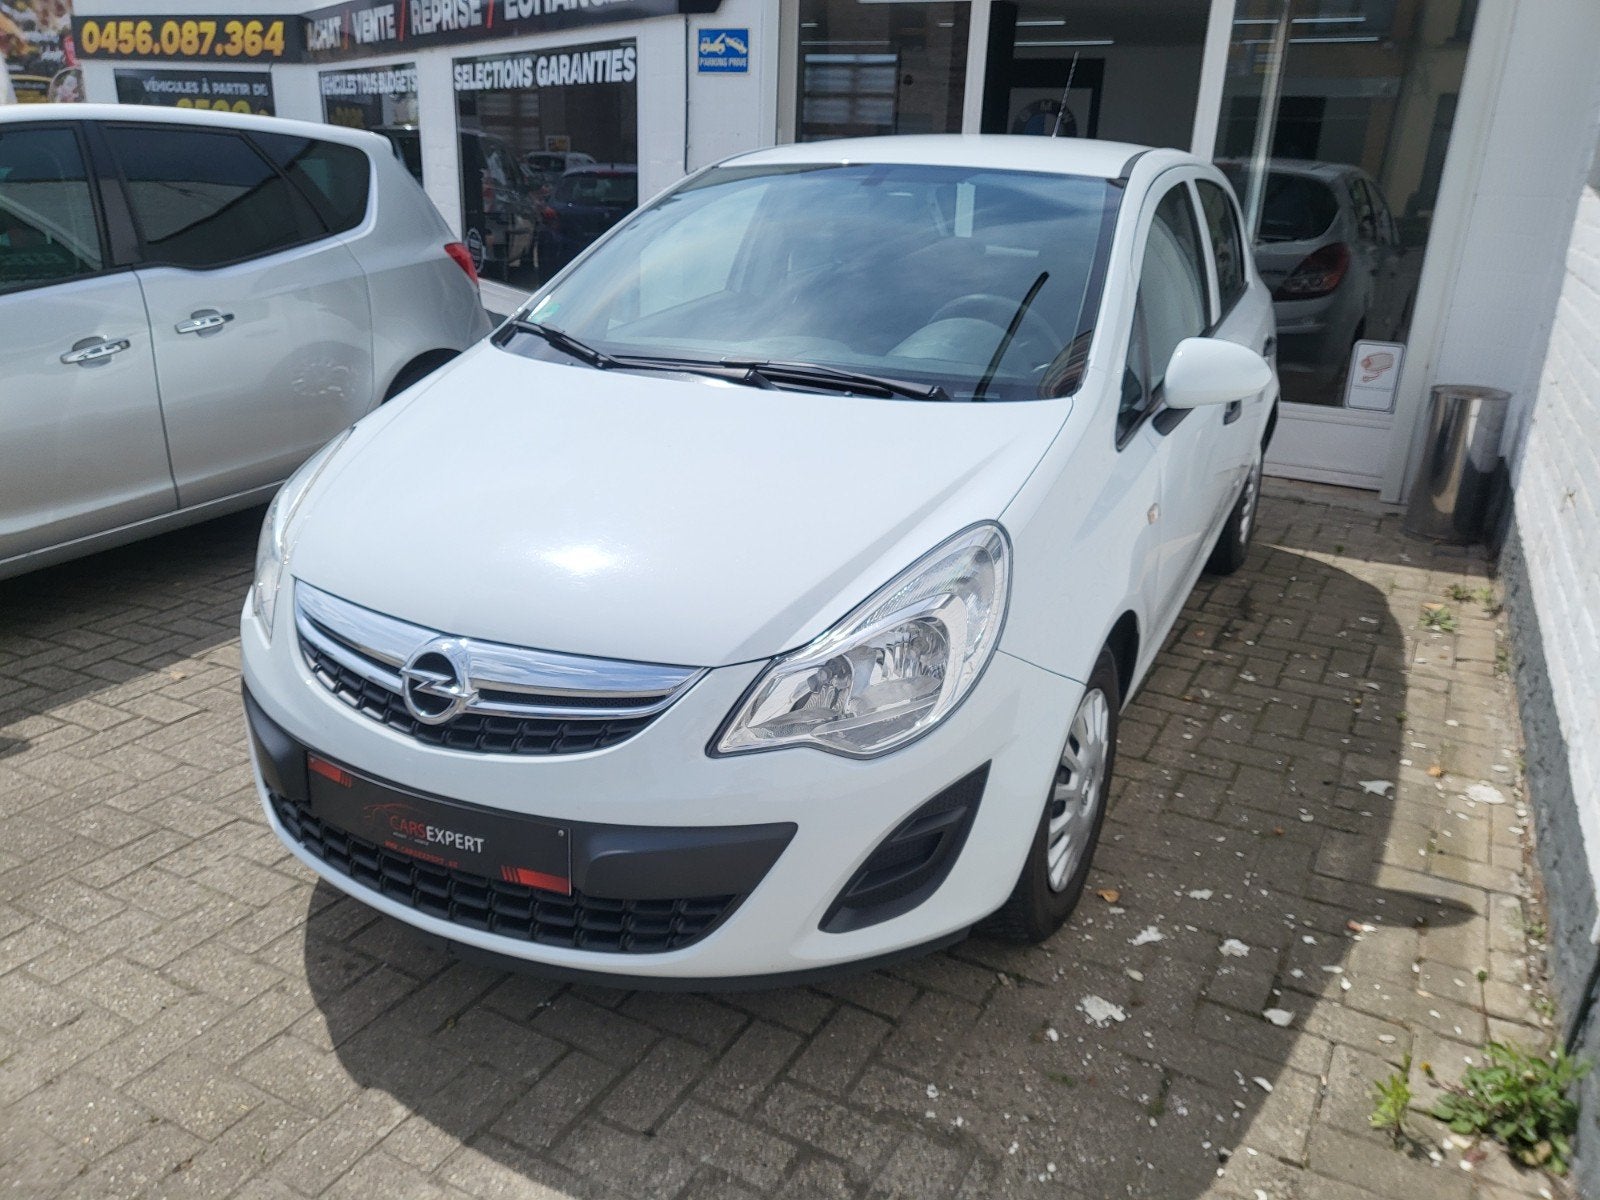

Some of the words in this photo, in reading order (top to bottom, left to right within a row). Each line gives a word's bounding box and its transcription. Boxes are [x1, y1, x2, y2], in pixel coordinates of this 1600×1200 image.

[82, 20, 285, 57] 0456.087.364
[352, 4, 396, 44] VENTE
[410, 0, 482, 36] REPRISE
[212, 82, 250, 96] PARTIR
[454, 57, 533, 91] SELECTIONS
[536, 47, 636, 87] GARANTIES
